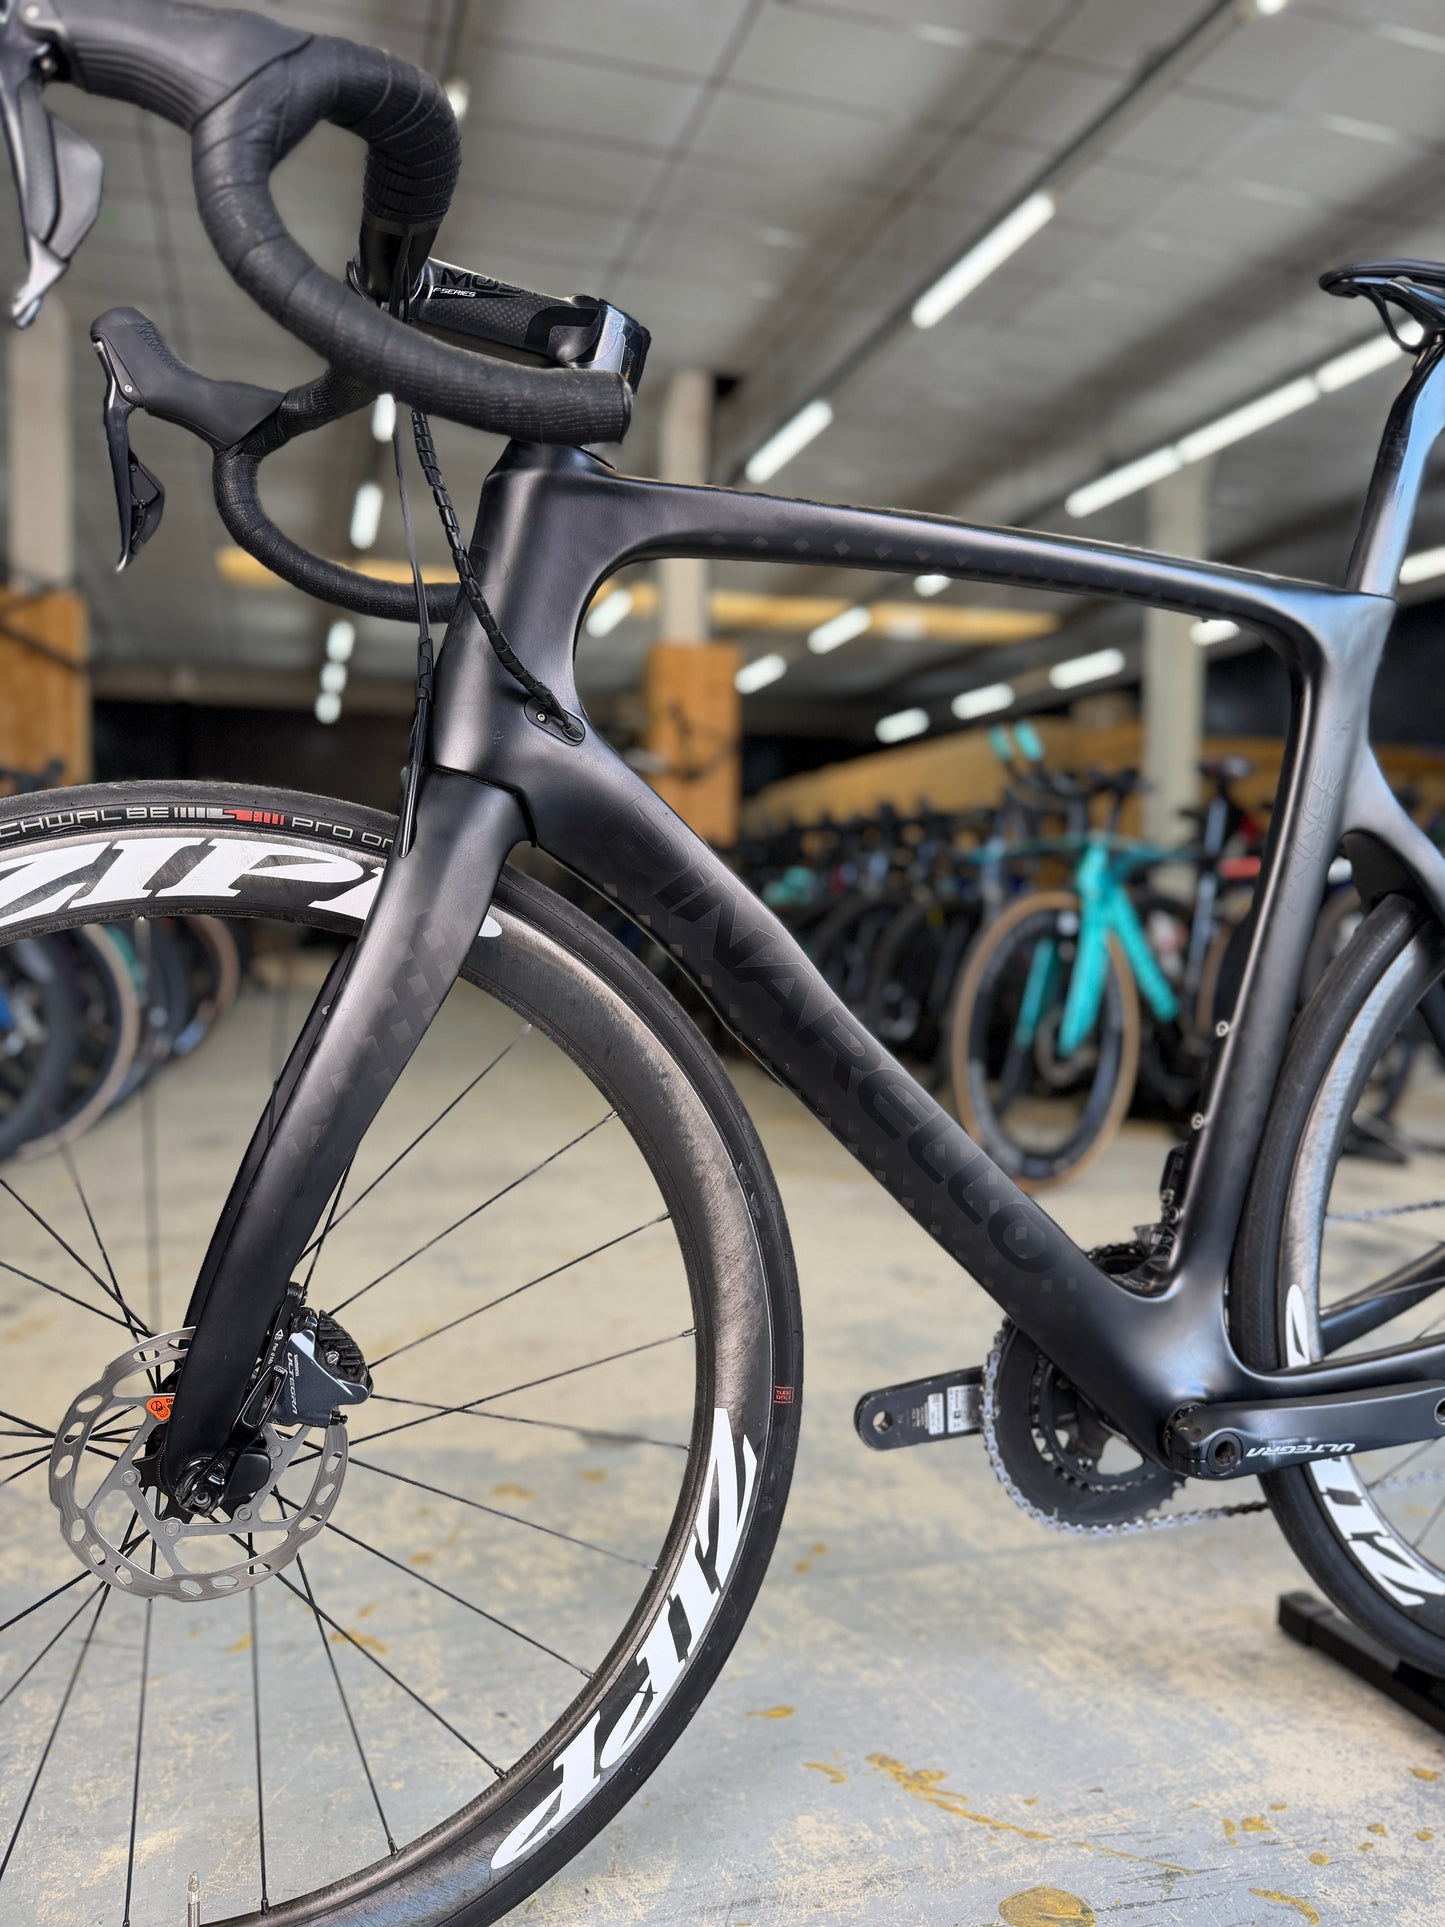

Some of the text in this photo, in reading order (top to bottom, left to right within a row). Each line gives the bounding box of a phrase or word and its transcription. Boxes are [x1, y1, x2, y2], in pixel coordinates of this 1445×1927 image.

[591, 795, 1062, 1274] PINARELLO
[287, 1352, 298, 1415] ULTEGRA
[1245, 1442, 1356, 1458] ULTEGRA
[491, 1407, 758, 1870] ZIPP
